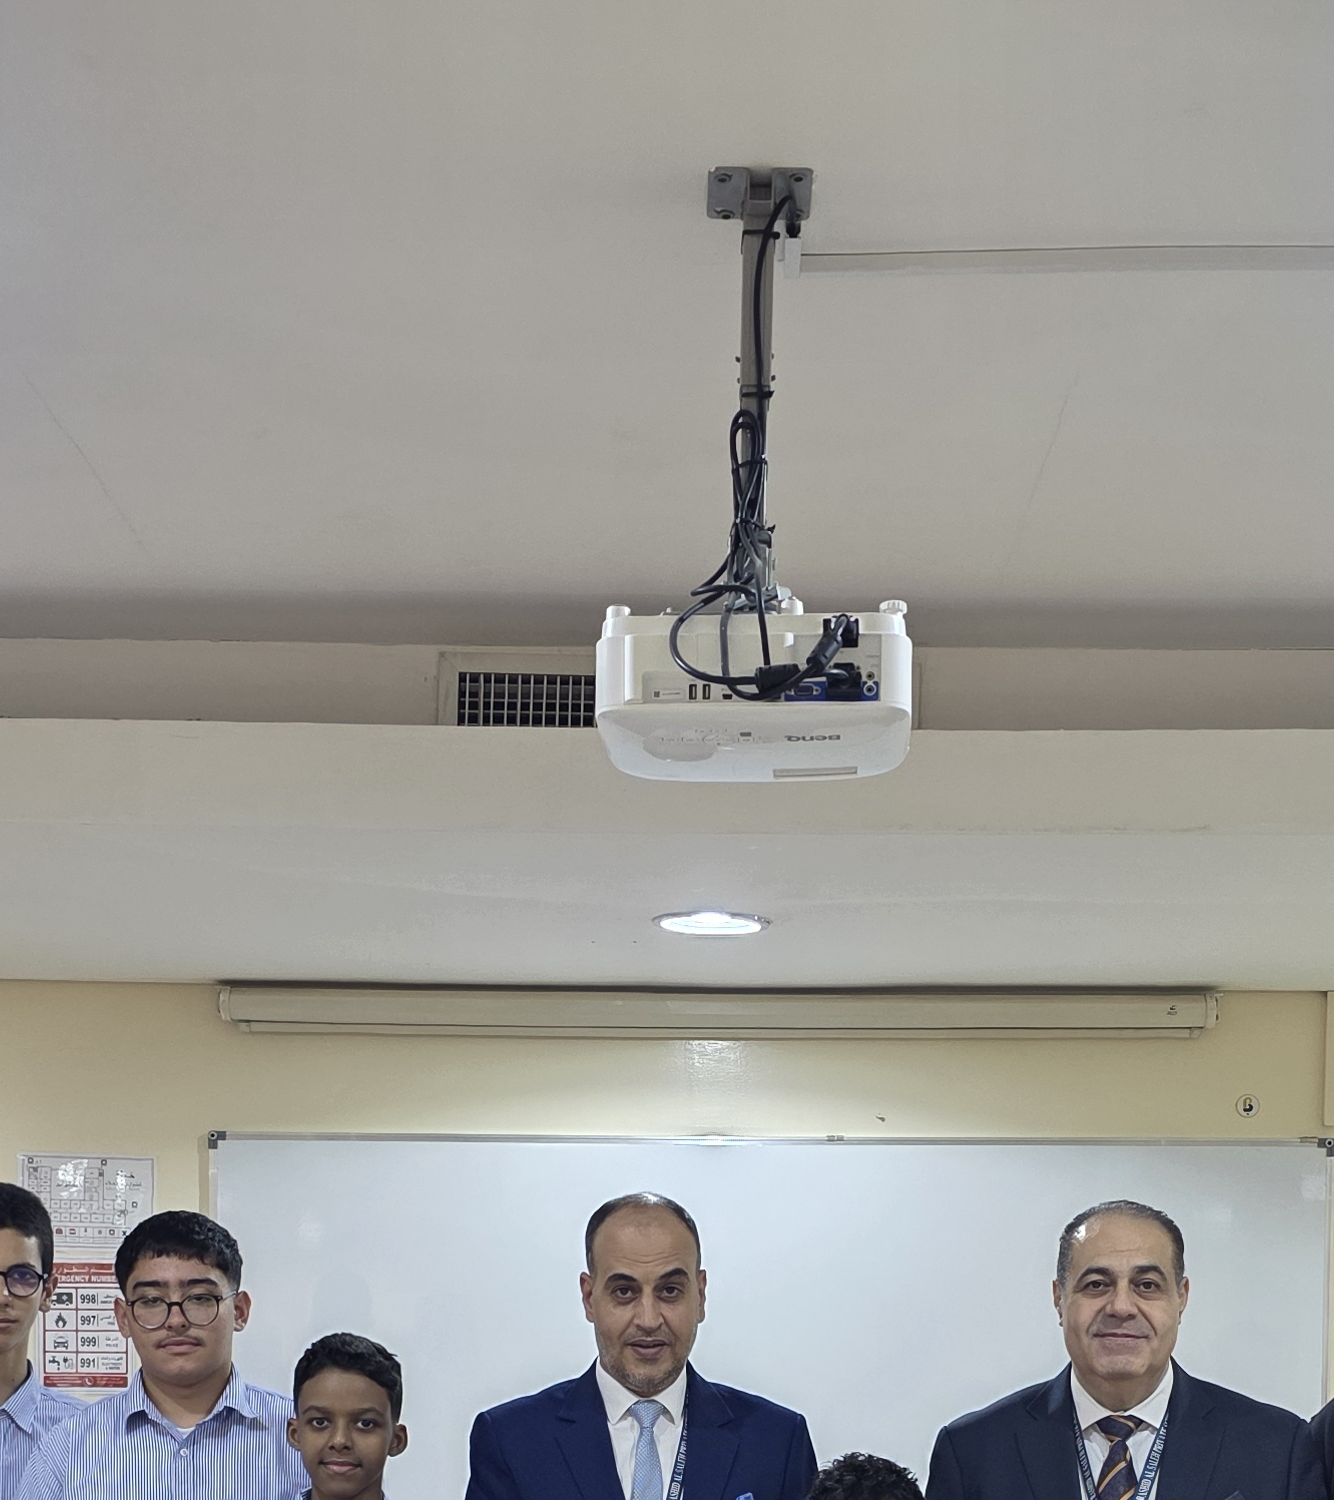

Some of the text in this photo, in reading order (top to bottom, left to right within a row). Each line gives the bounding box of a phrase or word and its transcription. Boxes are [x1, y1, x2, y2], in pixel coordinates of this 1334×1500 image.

[58, 1275, 89, 1283] ERGENCY
[80, 1294, 96, 1304] 998
[80, 1315, 96, 1326] 997
[80, 1336, 97, 1347] 999
[80, 1358, 96, 1368] 991
[1147, 1452, 1160, 1471] SALEH
[1144, 1470, 1155, 1480] AL
[1136, 1479, 1151, 1500] RASHID
